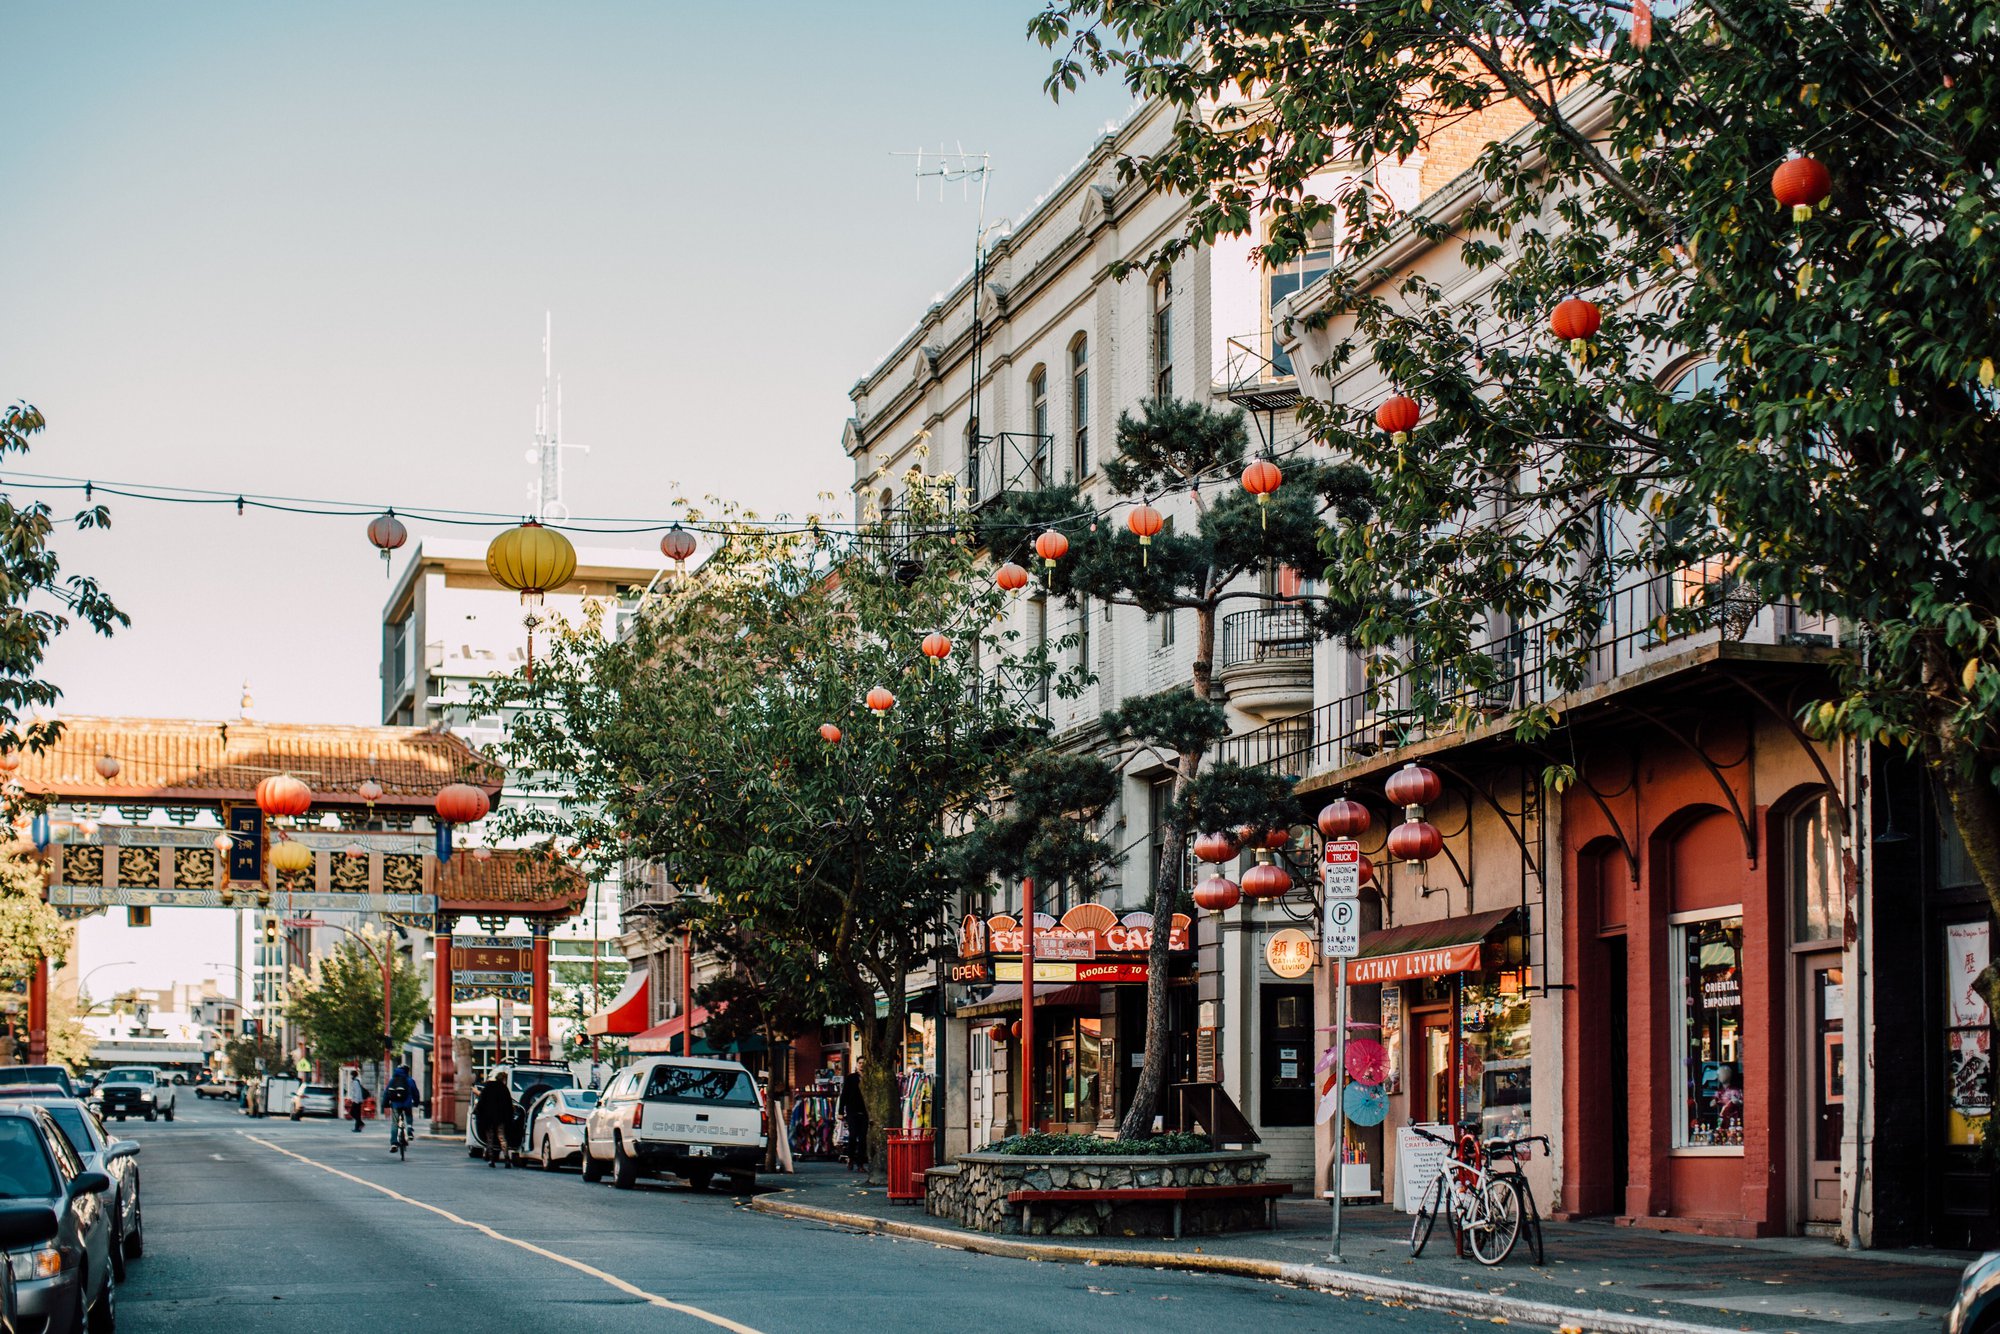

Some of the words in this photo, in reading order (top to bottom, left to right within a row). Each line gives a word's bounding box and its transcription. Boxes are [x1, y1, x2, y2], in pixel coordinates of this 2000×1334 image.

[1326, 843, 1358, 853] COMMERCIAL
[1332, 853, 1352, 862] TRUCK
[1332, 866, 1352, 874] LOADING
[1327, 945, 1355, 953] SATURDAY
[1272, 957, 1302, 965] CATHAY
[1355, 959, 1399, 982] CATHAY
[1406, 951, 1452, 975] LIVING
[952, 963, 981, 981] OPEN
[1079, 965, 1119, 980] NOODLES
[1131, 966, 1142, 974] TO
[1281, 963, 1306, 971] LIVING
[1705, 980, 1740, 993] ORIENTAL
[1703, 995, 1741, 1009] EMPORIUM
[652, 1121, 749, 1137] CHEVROLET
